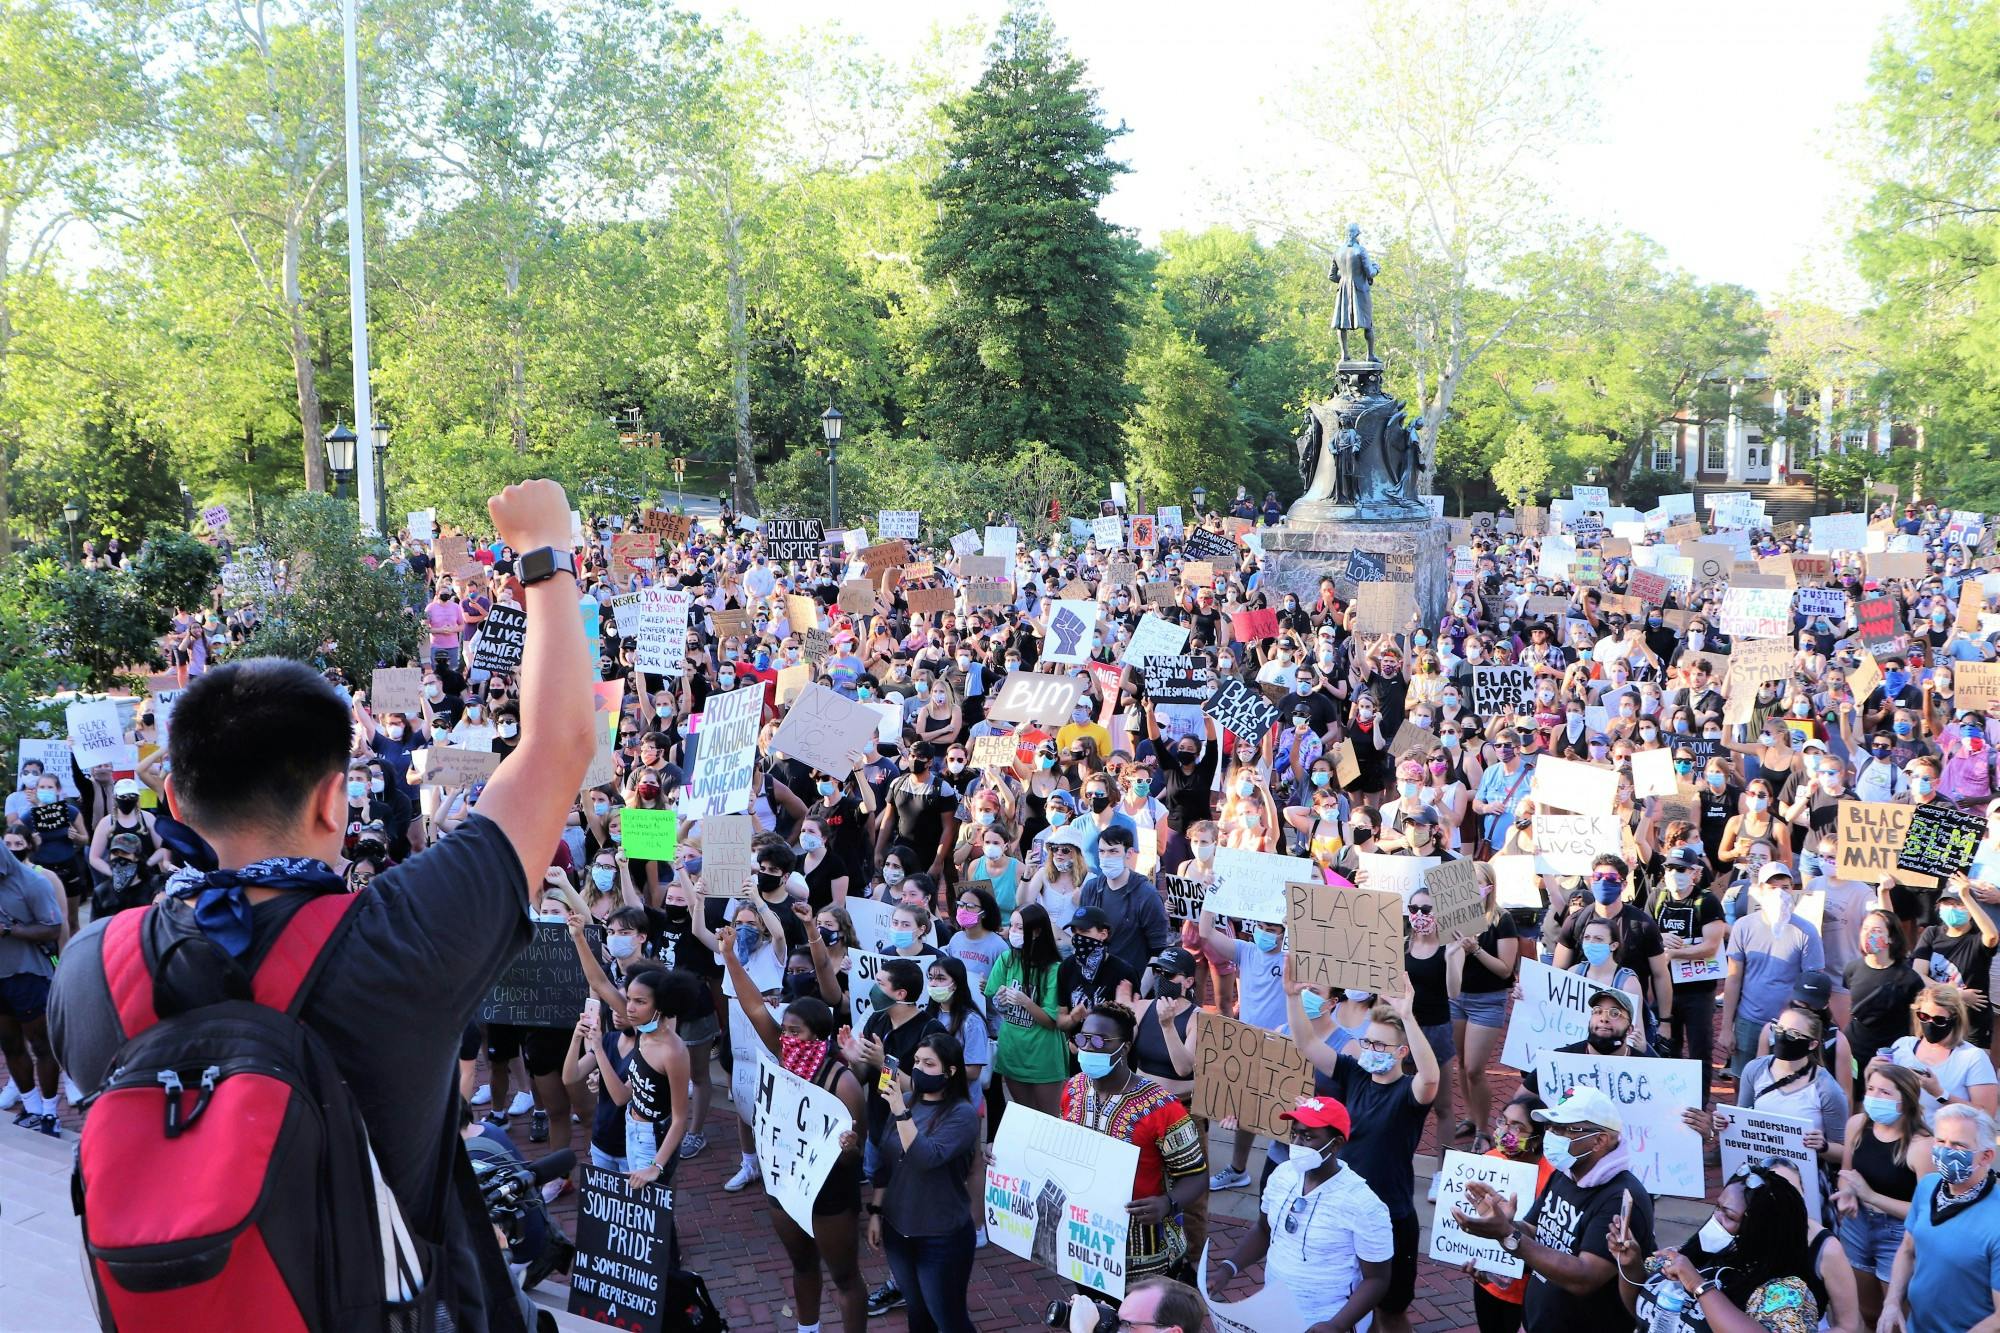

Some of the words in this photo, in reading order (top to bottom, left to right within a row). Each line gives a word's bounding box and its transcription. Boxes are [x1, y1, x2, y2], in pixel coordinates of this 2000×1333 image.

[1573, 487, 1606, 496] POLICIES
[649, 511, 684, 526] BLACK
[650, 520, 680, 531] LIVES
[643, 526, 686, 542] MATTER
[767, 519, 793, 540] BLACK
[794, 519, 819, 540] LIVES
[1196, 528, 1236, 550] DISMANTLING
[768, 541, 819, 560] INSPIRE
[1386, 554, 1414, 565] ENOUGH
[1792, 560, 1827, 573] VOTE
[1386, 571, 1414, 583] ENOUGH
[644, 591, 662, 603] YOU
[663, 593, 688, 604] KNOW
[1802, 590, 1843, 600] JUSTICE
[641, 603, 655, 613] THE
[656, 603, 677, 614] SYSTEM
[1745, 606, 1787, 618] PEACE
[1802, 605, 1836, 614] BREONNA
[1859, 600, 1894, 618] HOW
[666, 616, 685, 625] WHEN
[1858, 619, 1895, 637] MANY
[638, 633, 666, 643] STATUES
[669, 637, 683, 645] ARE
[639, 626, 684, 637] CONFEDERATE
[806, 628, 830, 644] BLACK
[479, 640, 522, 660] MATTER
[663, 648, 683, 656] OVER
[805, 640, 829, 655] LIVES
[636, 656, 661, 668] BLACK
[1146, 656, 1194, 669] VIRGINIA
[1959, 665, 1988, 673] BLACK
[1145, 665, 1157, 678] IS
[1157, 666, 1173, 679] FOR
[1477, 669, 1534, 691] BLACK
[1145, 679, 1169, 690] NOT
[1147, 687, 1174, 697] WHITE
[1959, 685, 1999, 697] MATTER
[806, 688, 853, 722] NO
[1004, 680, 1075, 715] BLM
[1223, 680, 1280, 729] BLACK
[705, 689, 748, 726] RIOT
[741, 700, 761, 715] THE
[1217, 693, 1261, 730] LIVES
[78, 721, 107, 734] BLACK
[784, 720, 825, 746] NO
[1206, 705, 1258, 746] MATTER
[83, 737, 116, 752] MATTER
[84, 731, 107, 741] LIVES
[698, 713, 760, 761] LANGUAGE
[978, 738, 1016, 748] BLACK
[704, 756, 720, 777] OF
[721, 750, 744, 773] THE
[971, 755, 1014, 765] MATTER
[692, 764, 753, 799] UNHEARD
[36, 804, 63, 814] BLACK
[703, 793, 729, 817] MLK
[38, 817, 65, 830] MATTER
[41, 811, 61, 820] LIVES
[1850, 806, 1905, 828] BLAC
[1913, 813, 1937, 824] Garner
[1917, 804, 1946, 818] George
[1946, 809, 1970, 822] Floyd
[1971, 816, 1987, 827] Eric
[708, 820, 744, 843] BLACK
[1537, 816, 1602, 836] BLACK
[1846, 826, 1899, 844] LIVE
[710, 848, 747, 863] LIVES
[1165, 876, 1184, 898] NO
[1208, 875, 1228, 895] BLM
[1426, 861, 1477, 896] BREONNA
[1433, 881, 1481, 913] TAYLOR
[1291, 886, 1401, 933] BLACK
[1437, 914, 1453, 932] SAY
[1451, 908, 1468, 928] HER
[1663, 919, 1686, 930] VANS
[536, 928, 560, 943] ARE
[1293, 924, 1398, 965] LIVES
[959, 951, 990, 965] VIRGINIA
[552, 967, 573, 984] YOU
[1271, 965, 1282, 977] Q
[1294, 954, 1406, 993] MATTER
[493, 985, 539, 1002] CHOSEN
[545, 987, 562, 999] THE
[482, 1003, 503, 1020] OF
[507, 1005, 530, 1019] THE
[1019, 1018, 1033, 1029] SHOP
[1201, 1019, 1315, 1080] ABOLISH
[628, 1058, 657, 1094] Black
[1202, 1047, 1315, 1105] POLICE
[1545, 1060, 1652, 1105] Justice
[1204, 1077, 1291, 1136] UNIO
[1728, 1114, 1736, 1124] I
[1747, 1119, 1803, 1136] understand
[1741, 1129, 1760, 1141] that
[1760, 1132, 1767, 1142] I
[1767, 1133, 1784, 1146] will
[1725, 1138, 1752, 1151] never
[1753, 1143, 1812, 1162] understand.
[1455, 1163, 1510, 1185] SOUTH
[585, 1167, 620, 1195] WHERE
[654, 1187, 673, 1211] THE
[985, 1186, 1012, 1211] JOIN
[1011, 1194, 1034, 1220] HANDS
[988, 1206, 998, 1227] &
[1070, 1204, 1090, 1224] THE
[1091, 1212, 1128, 1242] SLAVES
[1068, 1220, 1116, 1256] THAT
[1068, 1241, 1102, 1268] BUILT
[1103, 1257, 1123, 1278] OLD
[1435, 1235, 1517, 1267] COMMUNITIES
[575, 1250, 588, 1269] IN
[591, 1255, 659, 1292] SOMETHING
[1071, 1260, 1106, 1291] UVA
[572, 1273, 597, 1294] THAT
[598, 1282, 657, 1316] REPRESENTS
[607, 1302, 617, 1318] A
